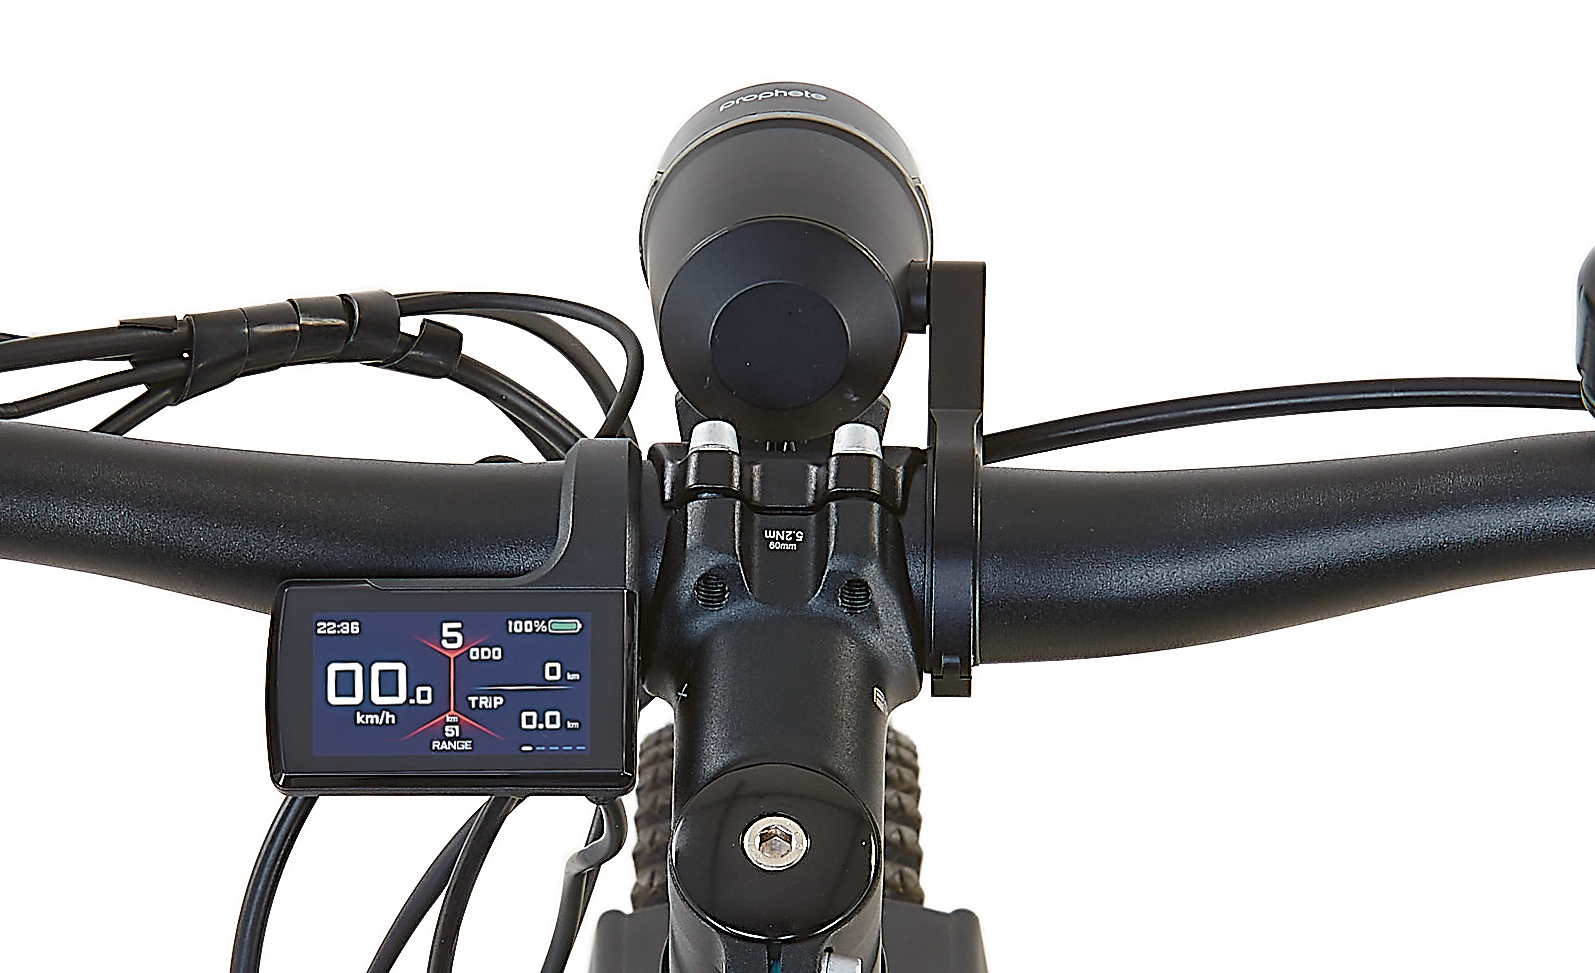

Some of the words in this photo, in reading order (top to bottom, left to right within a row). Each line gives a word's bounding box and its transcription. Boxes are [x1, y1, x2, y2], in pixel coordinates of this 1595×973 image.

[764, 529, 804, 542] 5.2Nm
[316, 621, 360, 634] 22:36
[507, 620, 548, 634] 100%
[440, 622, 464, 649] 5
[469, 647, 502, 660] ODO
[544, 662, 562, 680] 0
[566, 672, 581, 680] km
[327, 662, 433, 705] 00.0
[467, 696, 504, 709] TRIP
[356, 711, 396, 725] km/h
[445, 714, 459, 722] km
[521, 711, 561, 729] 0.0
[566, 721, 580, 729] km
[444, 725, 460, 737] 51
[431, 740, 473, 751] RANGE
